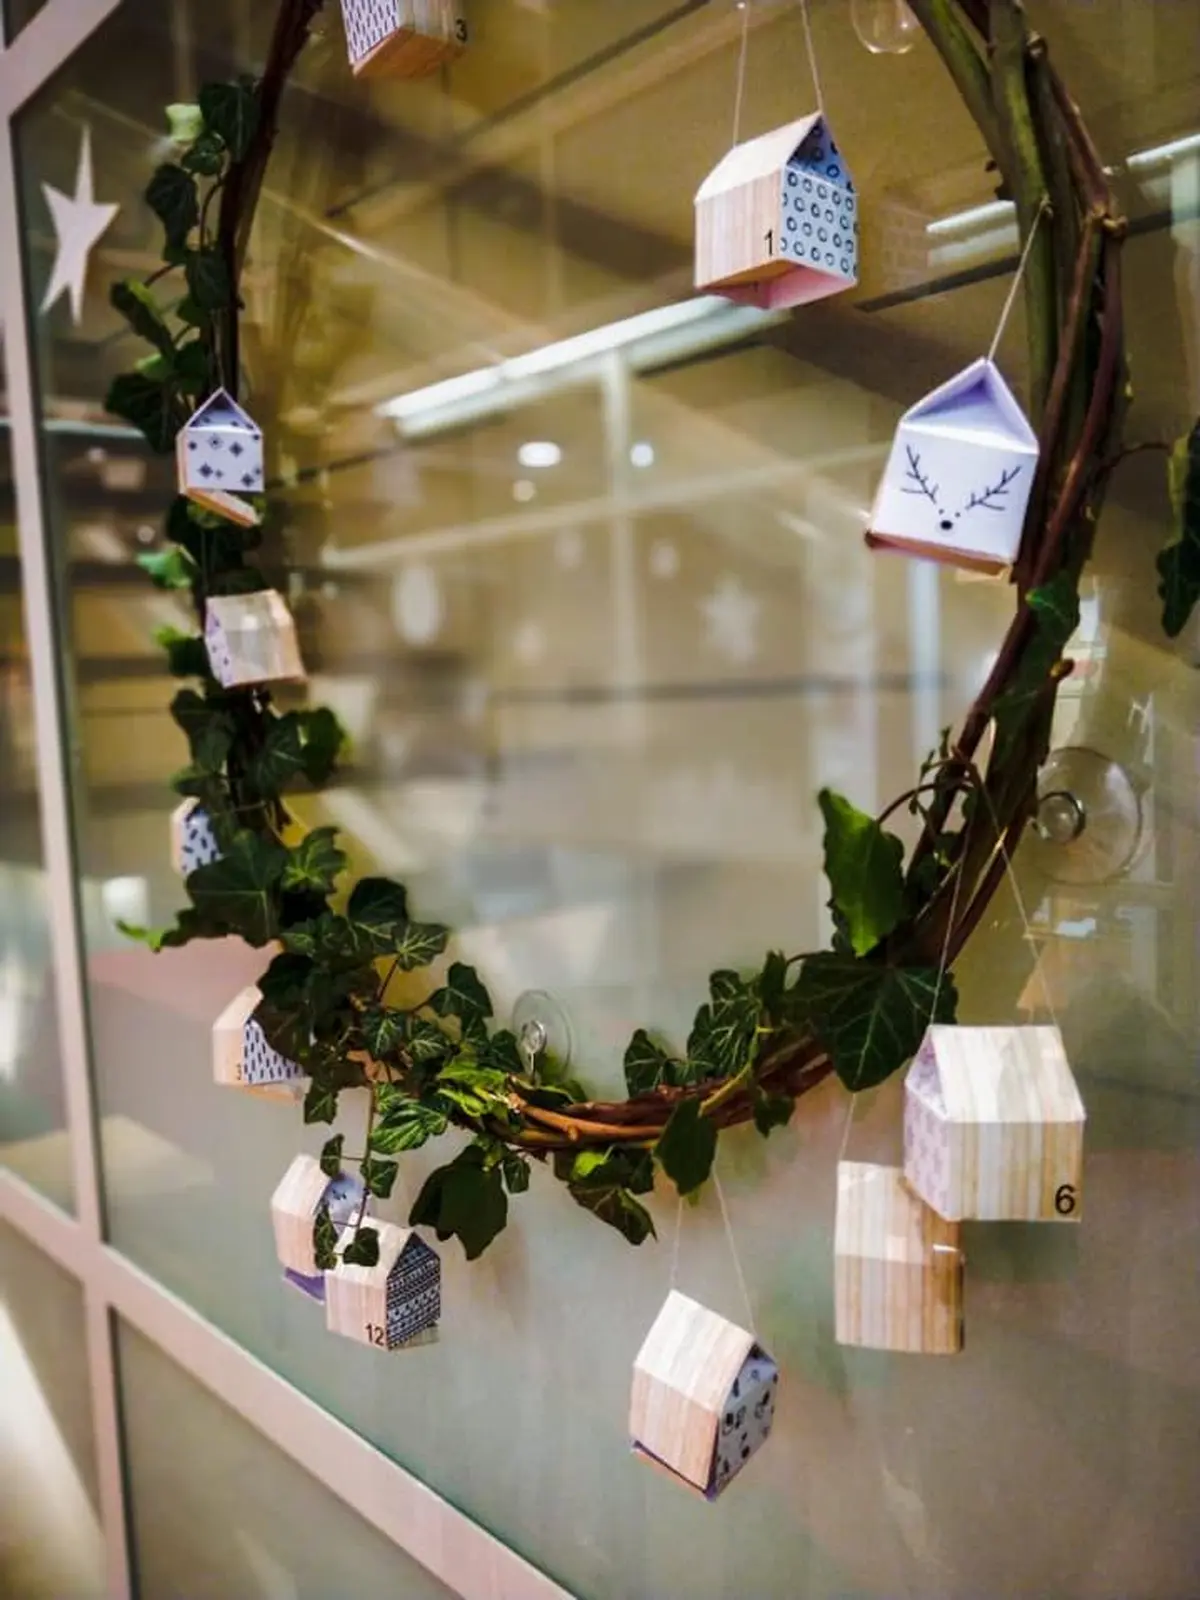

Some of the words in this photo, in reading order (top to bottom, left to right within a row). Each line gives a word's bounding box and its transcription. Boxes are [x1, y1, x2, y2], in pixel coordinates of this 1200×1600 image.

[456, 18, 468, 43] 3
[764, 229, 773, 257] 1
[1055, 1184, 1075, 1215] 6
[366, 1323, 385, 1347] 12
